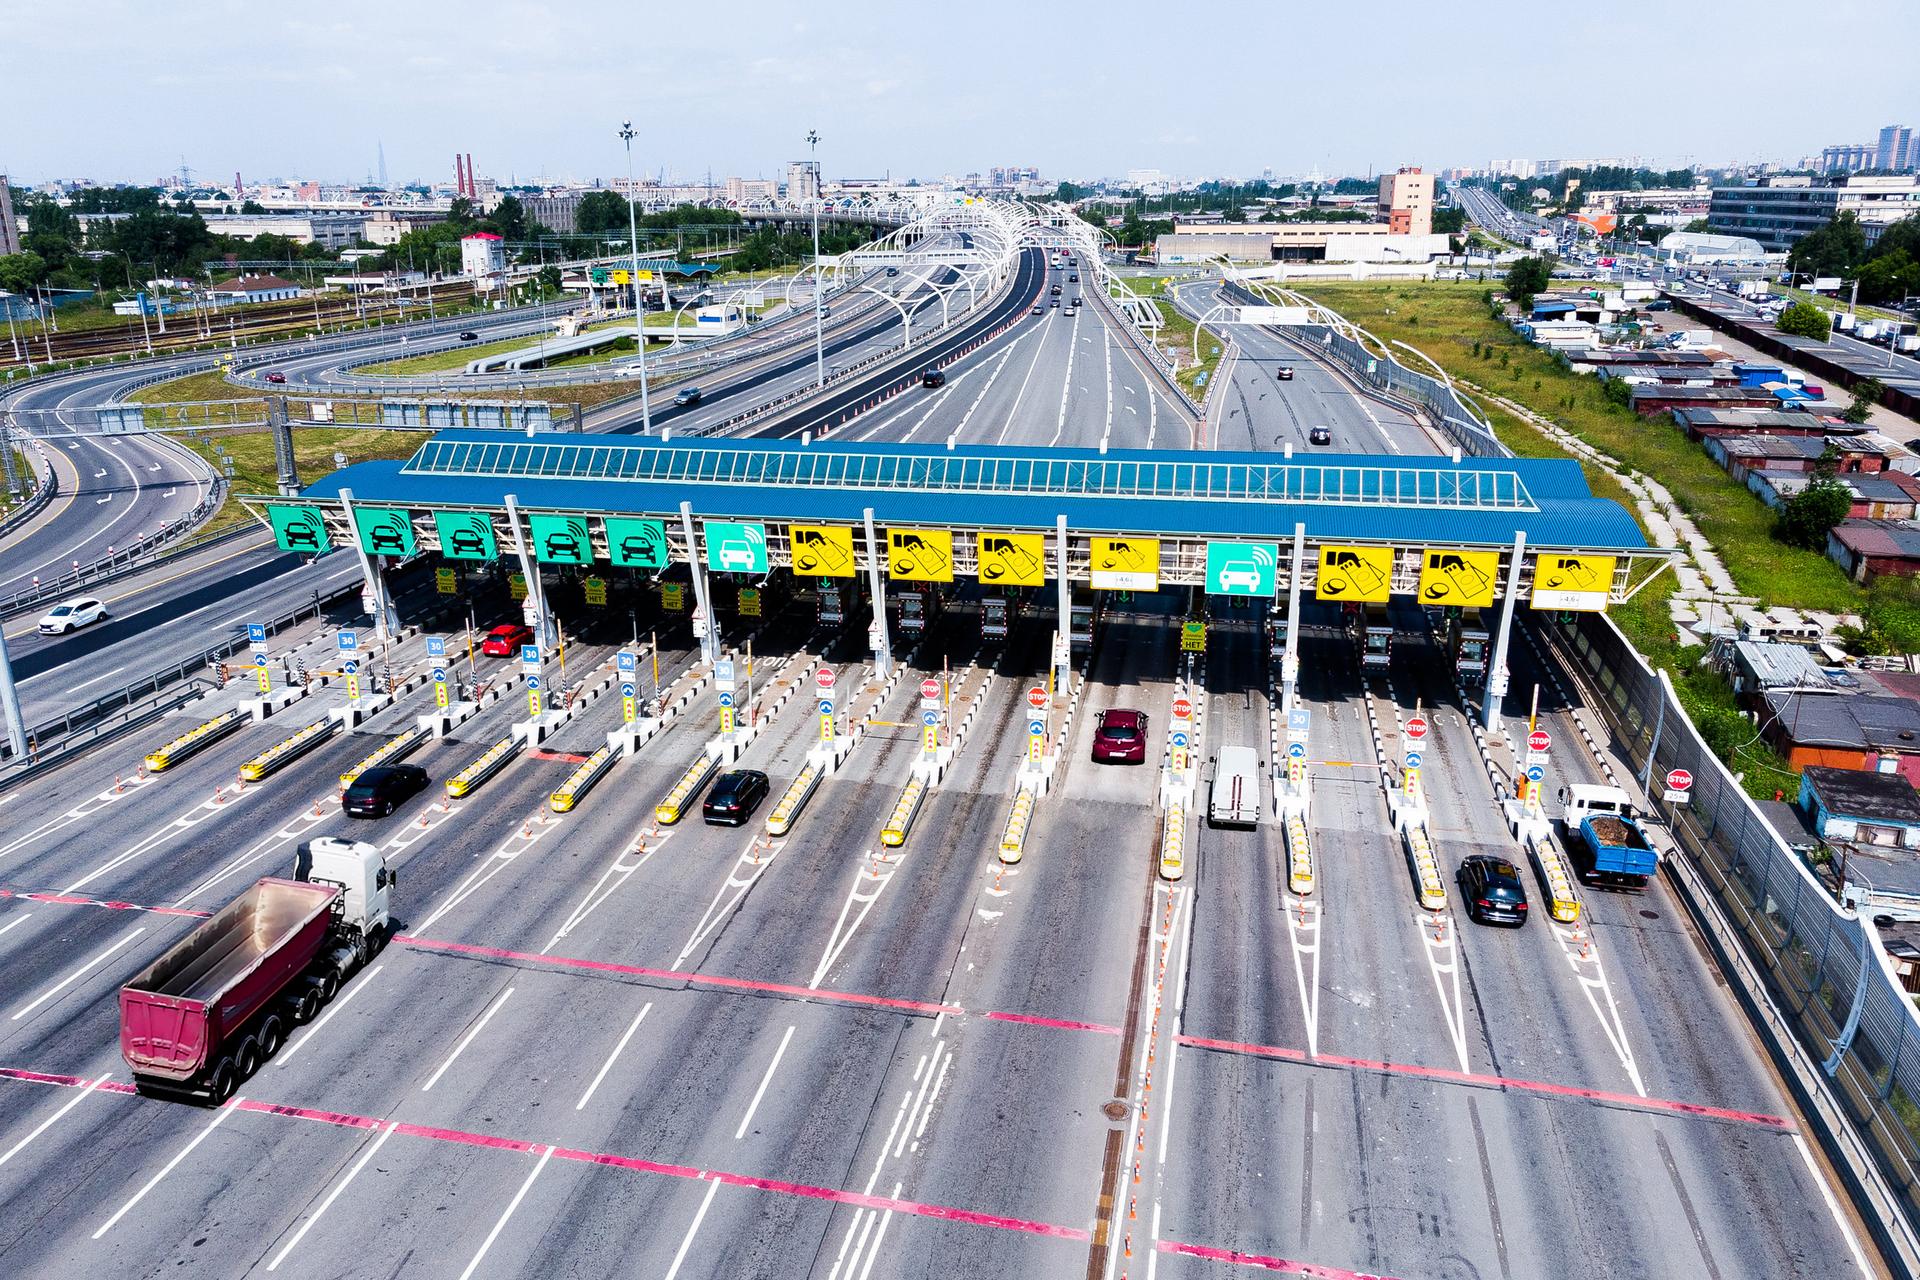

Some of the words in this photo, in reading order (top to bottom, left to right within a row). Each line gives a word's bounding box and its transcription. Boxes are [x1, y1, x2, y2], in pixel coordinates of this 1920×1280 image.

[252, 628, 262, 636] 30
[342, 637, 353, 645] 30
[1185, 641, 1201, 649] НЕТ
[431, 642, 441, 650] 30
[525, 650, 537, 658] 30
[621, 657, 631, 665] 30
[718, 666, 729, 675] 30
[922, 685, 939, 693] STOP
[1028, 693, 1046, 701] STOP
[1293, 715, 1306, 724] 30
[1529, 737, 1550, 745] STOP
[1669, 775, 1691, 784] STOP
